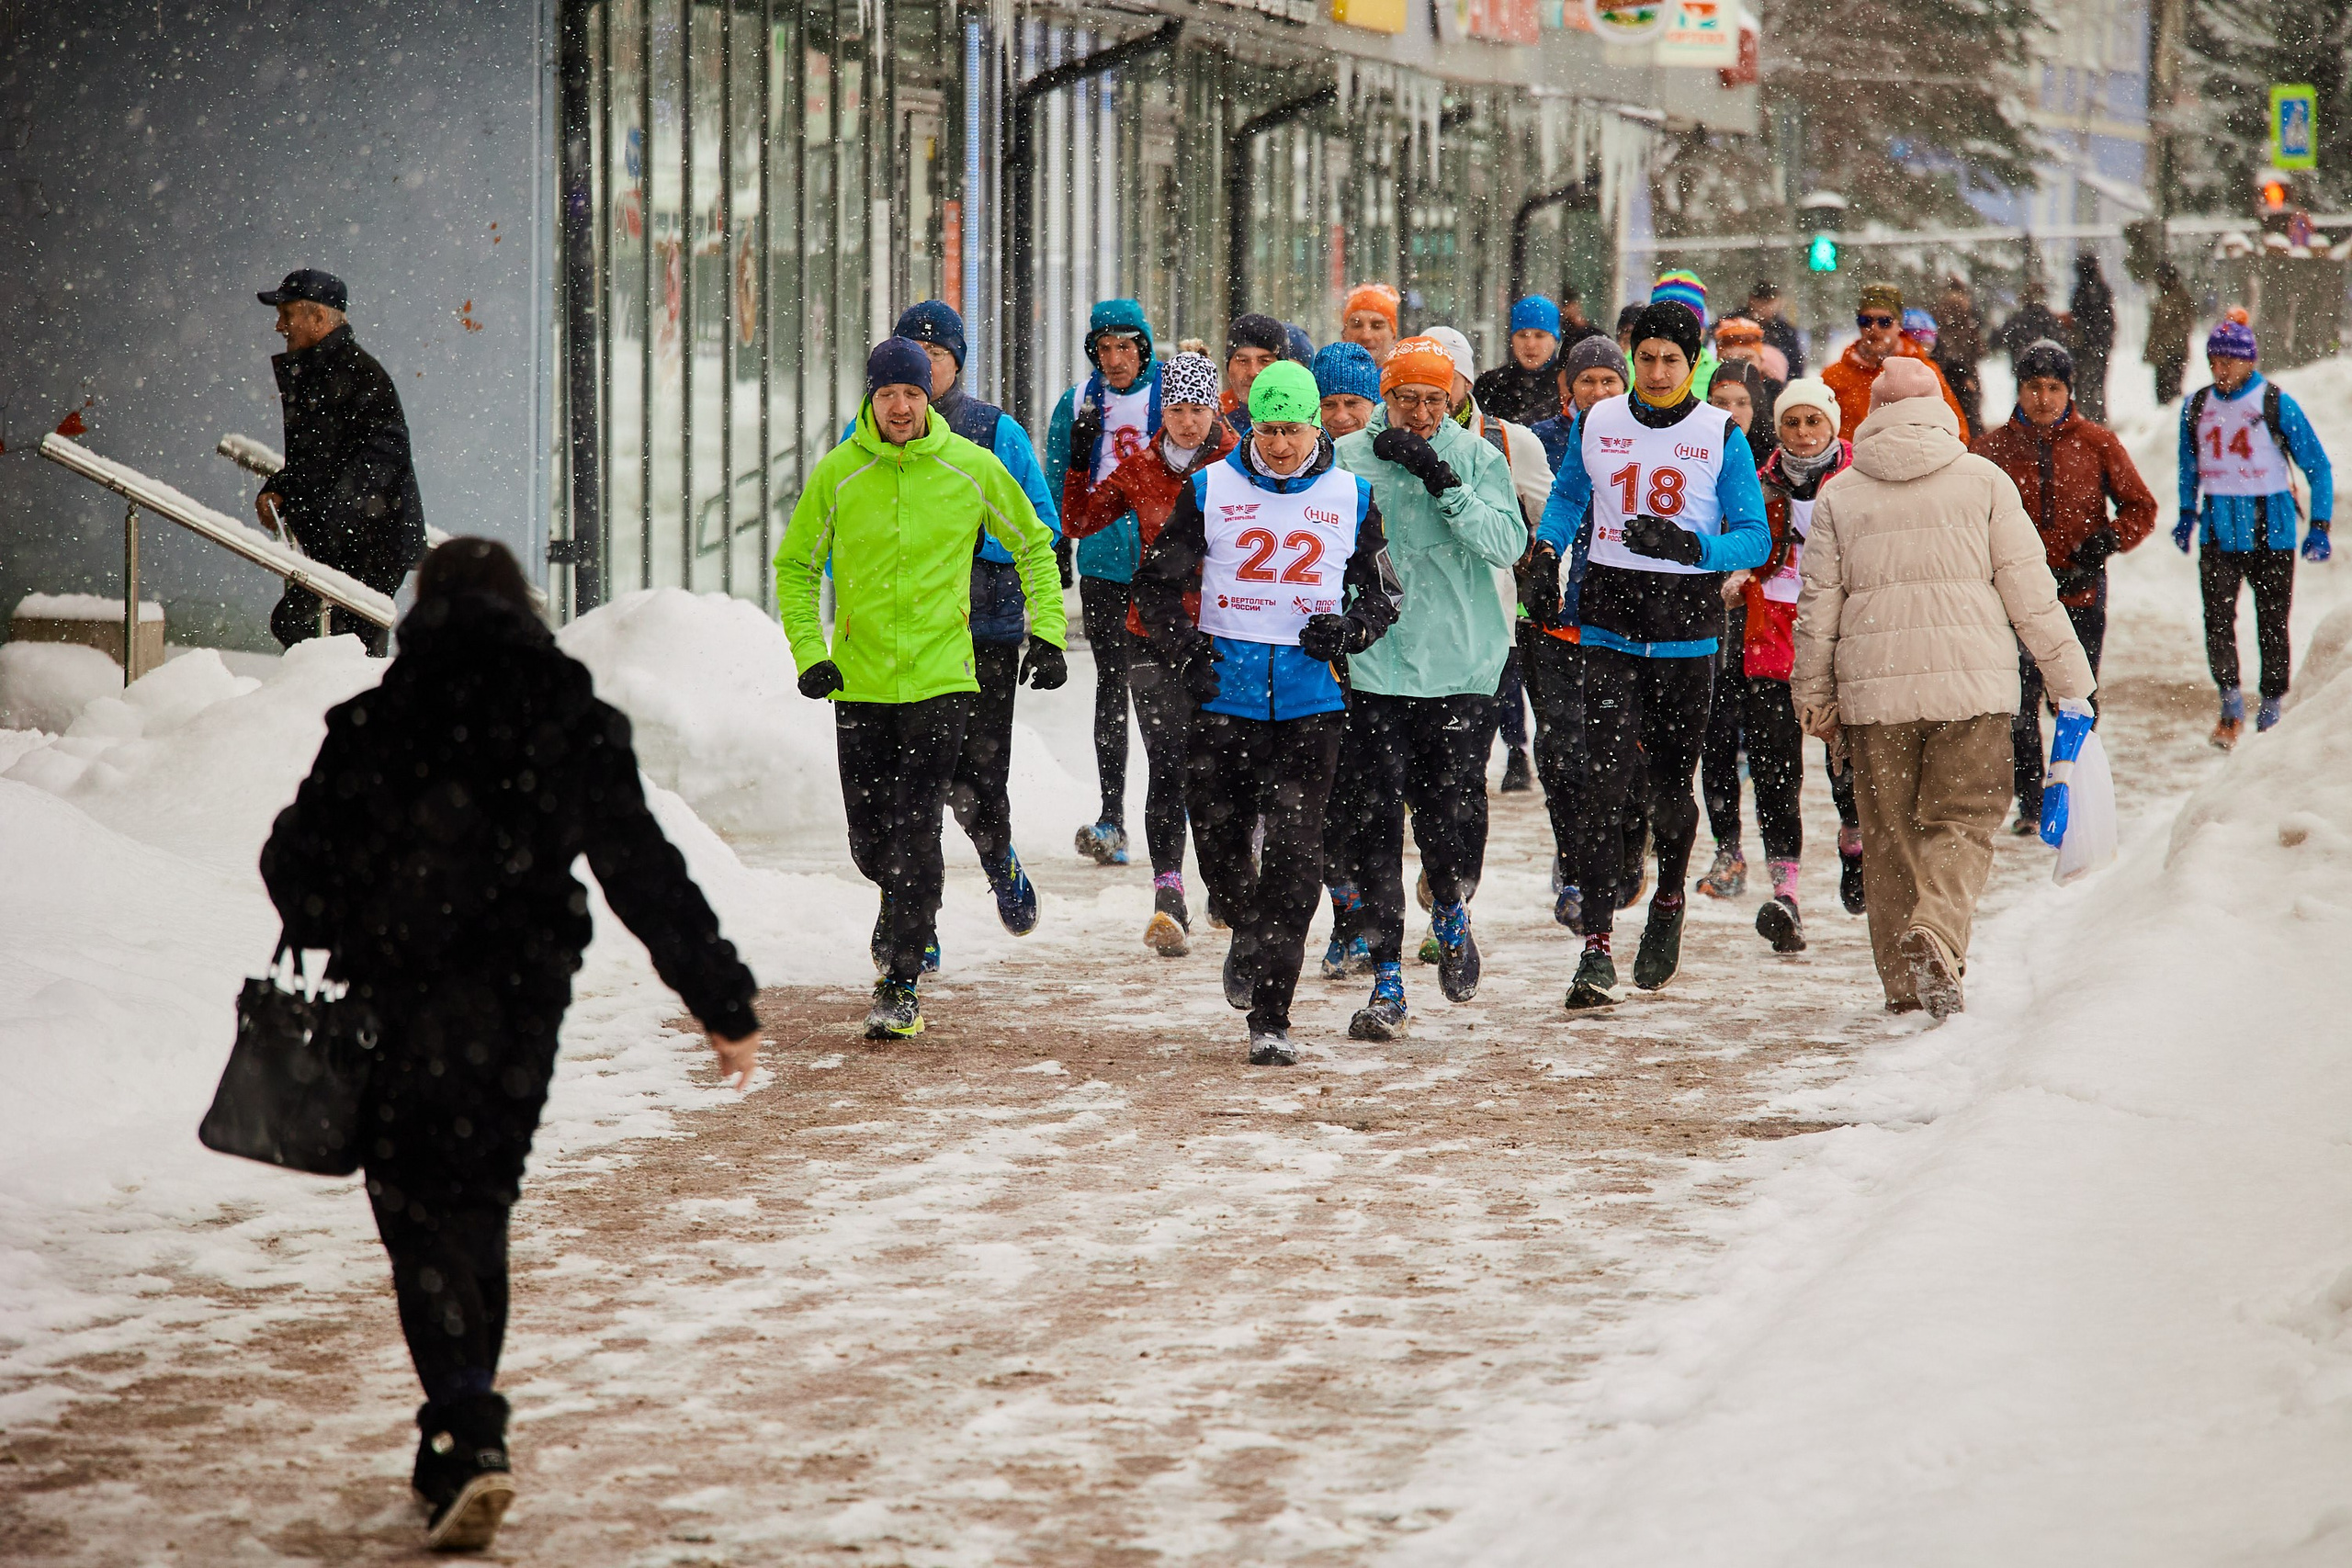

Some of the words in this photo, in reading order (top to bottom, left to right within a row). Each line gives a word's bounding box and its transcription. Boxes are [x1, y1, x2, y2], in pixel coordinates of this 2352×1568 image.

[1113, 424, 1143, 464] 6
[1679, 446, 1709, 459] НЦВ
[2205, 426, 2254, 460] 14
[1611, 462, 1687, 518] 18
[1310, 509, 1339, 525] НЦВ
[1236, 527, 1325, 585] 22
[1230, 603, 1261, 612] РОССИИ
[1231, 596, 1276, 606] ВЕРТОЛЕТЫ
